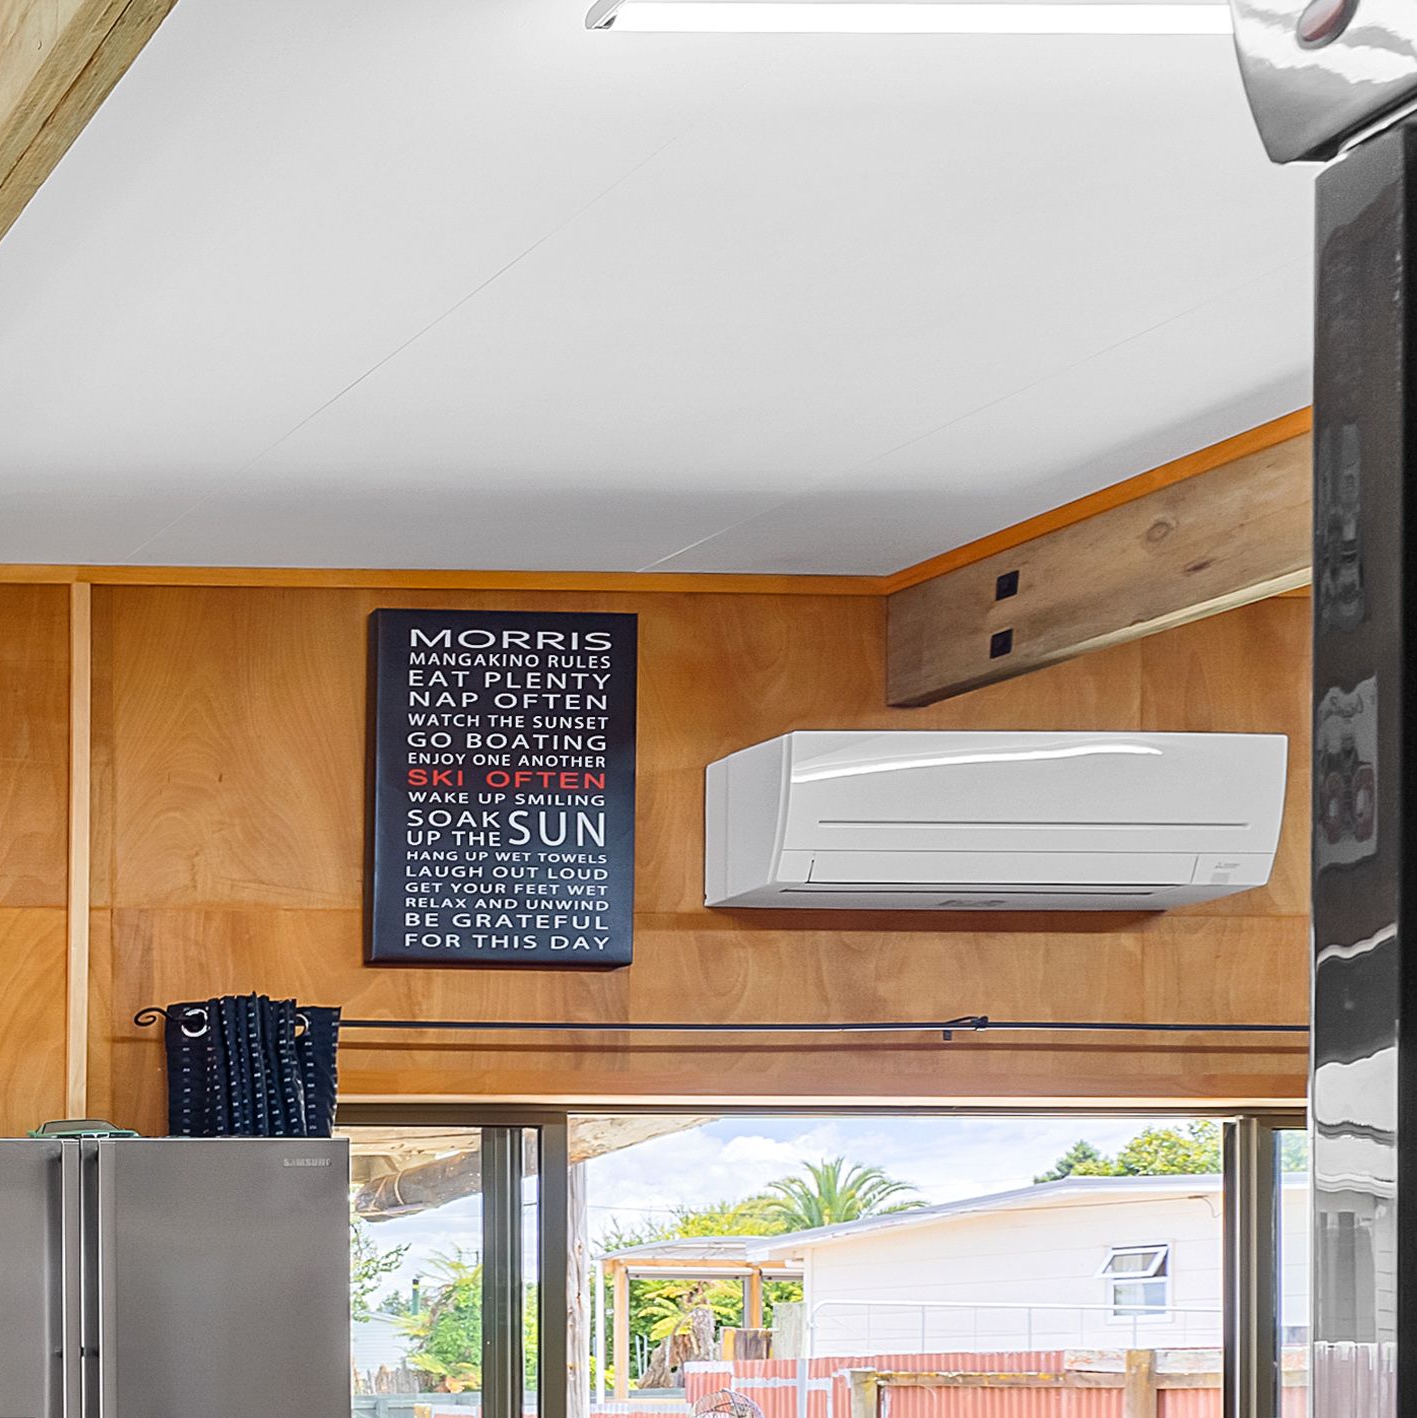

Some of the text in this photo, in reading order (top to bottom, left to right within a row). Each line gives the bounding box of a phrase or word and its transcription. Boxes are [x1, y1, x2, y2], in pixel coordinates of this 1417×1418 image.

[411, 629, 611, 650] MORRIS
[410, 652, 610, 668] MANGAKINO RULES
[409, 670, 610, 689] EAT PLENTY
[410, 692, 606, 709] NAP OFTEN
[409, 714, 608, 729] WATCH THE SUNSET
[408, 732, 605, 750] GO BOATING
[409, 753, 605, 767] ENJOY ONE ANOTHER
[409, 769, 604, 789] SKI OFTEN
[408, 792, 604, 806] WAKE UP SMILING
[407, 810, 604, 847] SOAK SUN
[407, 831, 501, 846] UP THE
[407, 851, 607, 864] HANG UP WET TOWELS
[406, 866, 607, 882] LAUGH OUT LOUD
[405, 882, 607, 898] GET YOUR FEET WET
[406, 898, 609, 912] RELAX AND UNWIND
[405, 913, 608, 930] BE GRATEFUL
[405, 934, 609, 951] FOR THIS DAY
